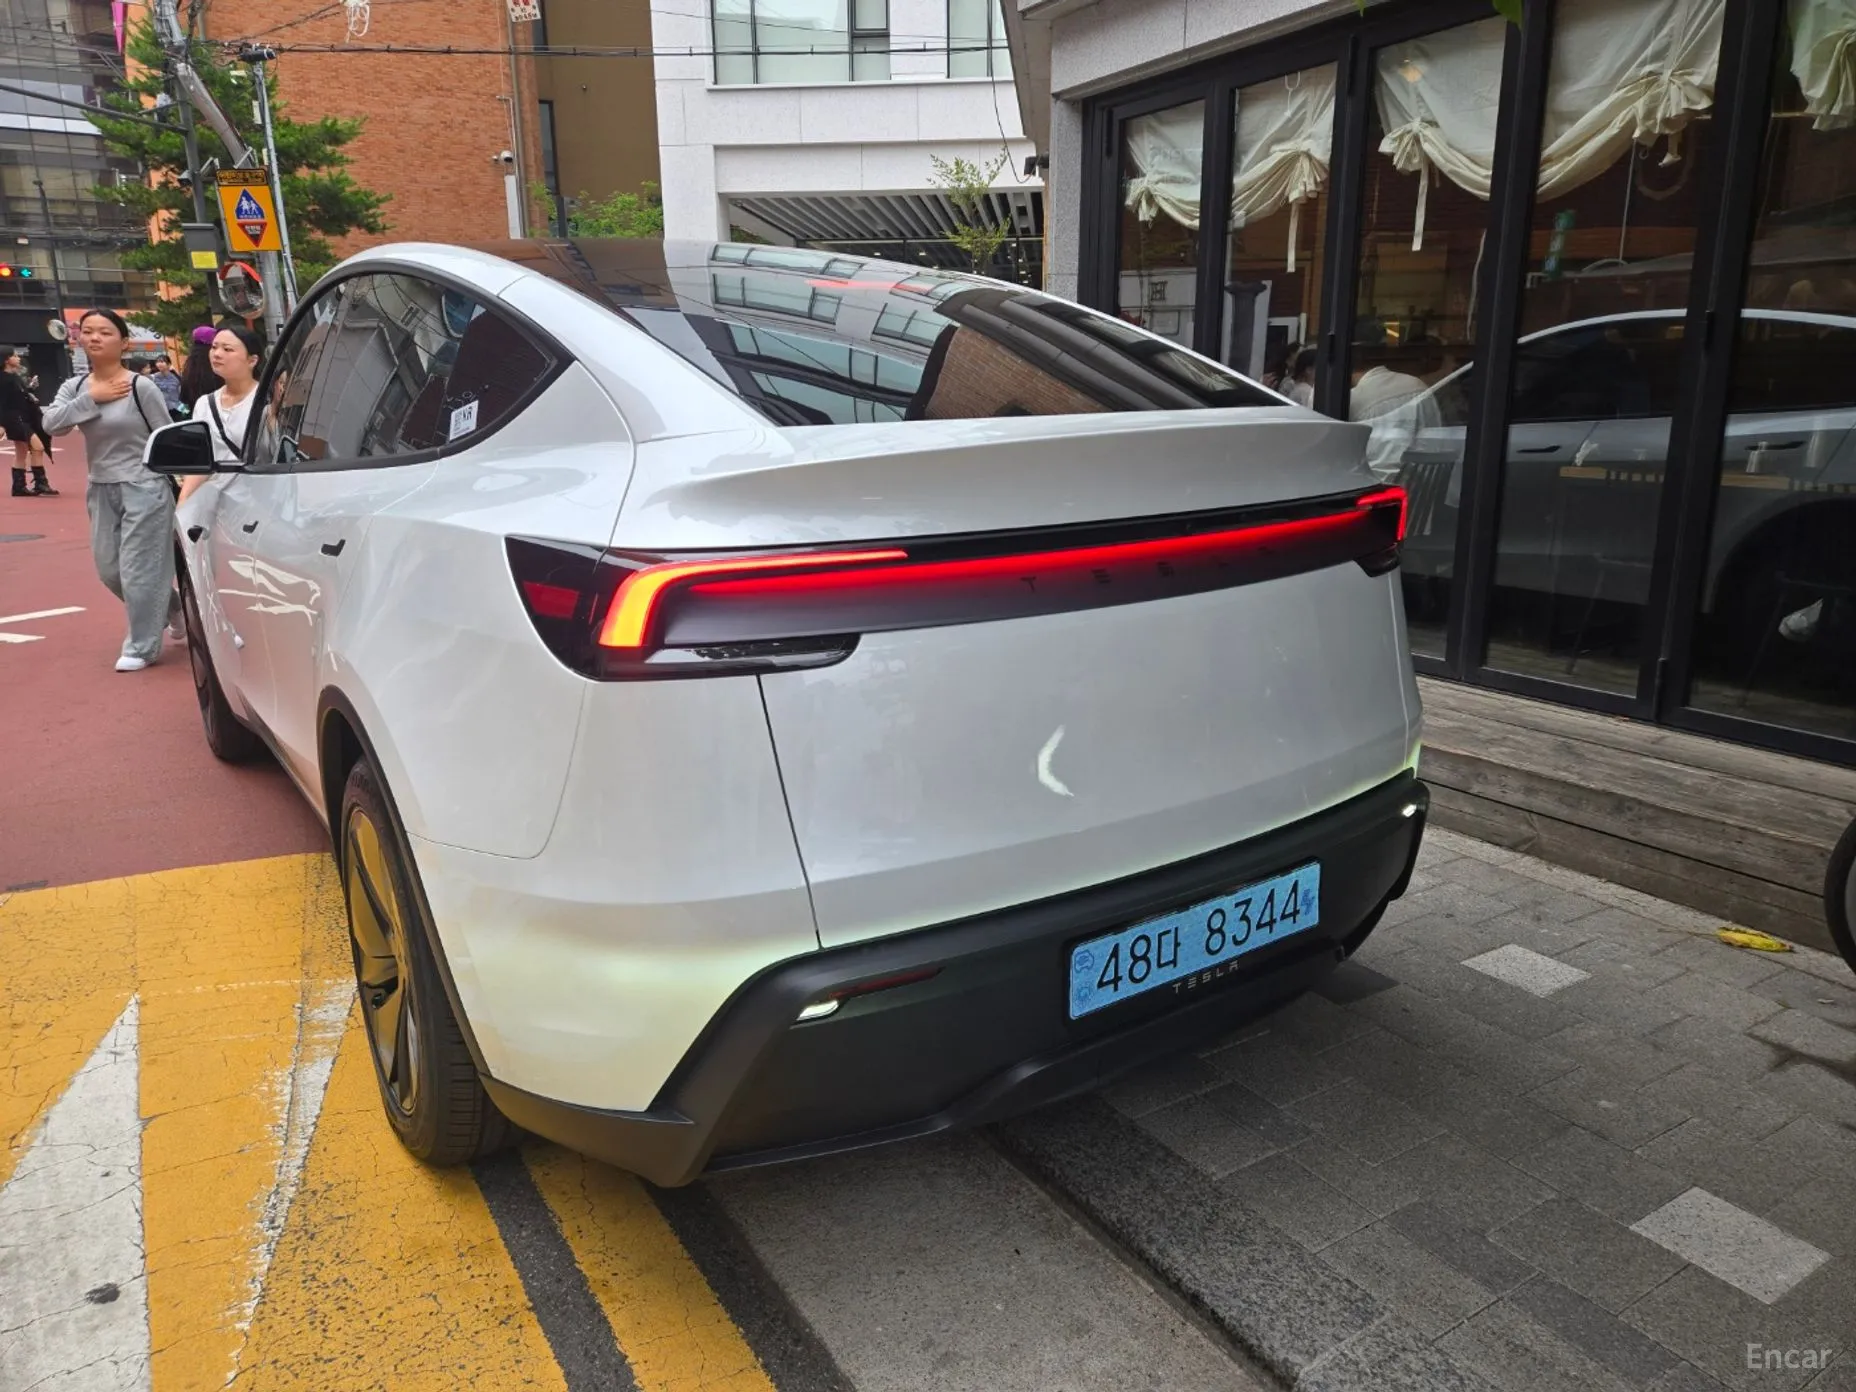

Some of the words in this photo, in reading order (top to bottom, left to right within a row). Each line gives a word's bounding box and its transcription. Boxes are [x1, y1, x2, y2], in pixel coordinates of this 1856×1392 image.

[1097, 926, 1181, 992] 48다
[1205, 879, 1300, 956] 8344
[1172, 960, 1240, 994] TESLA
